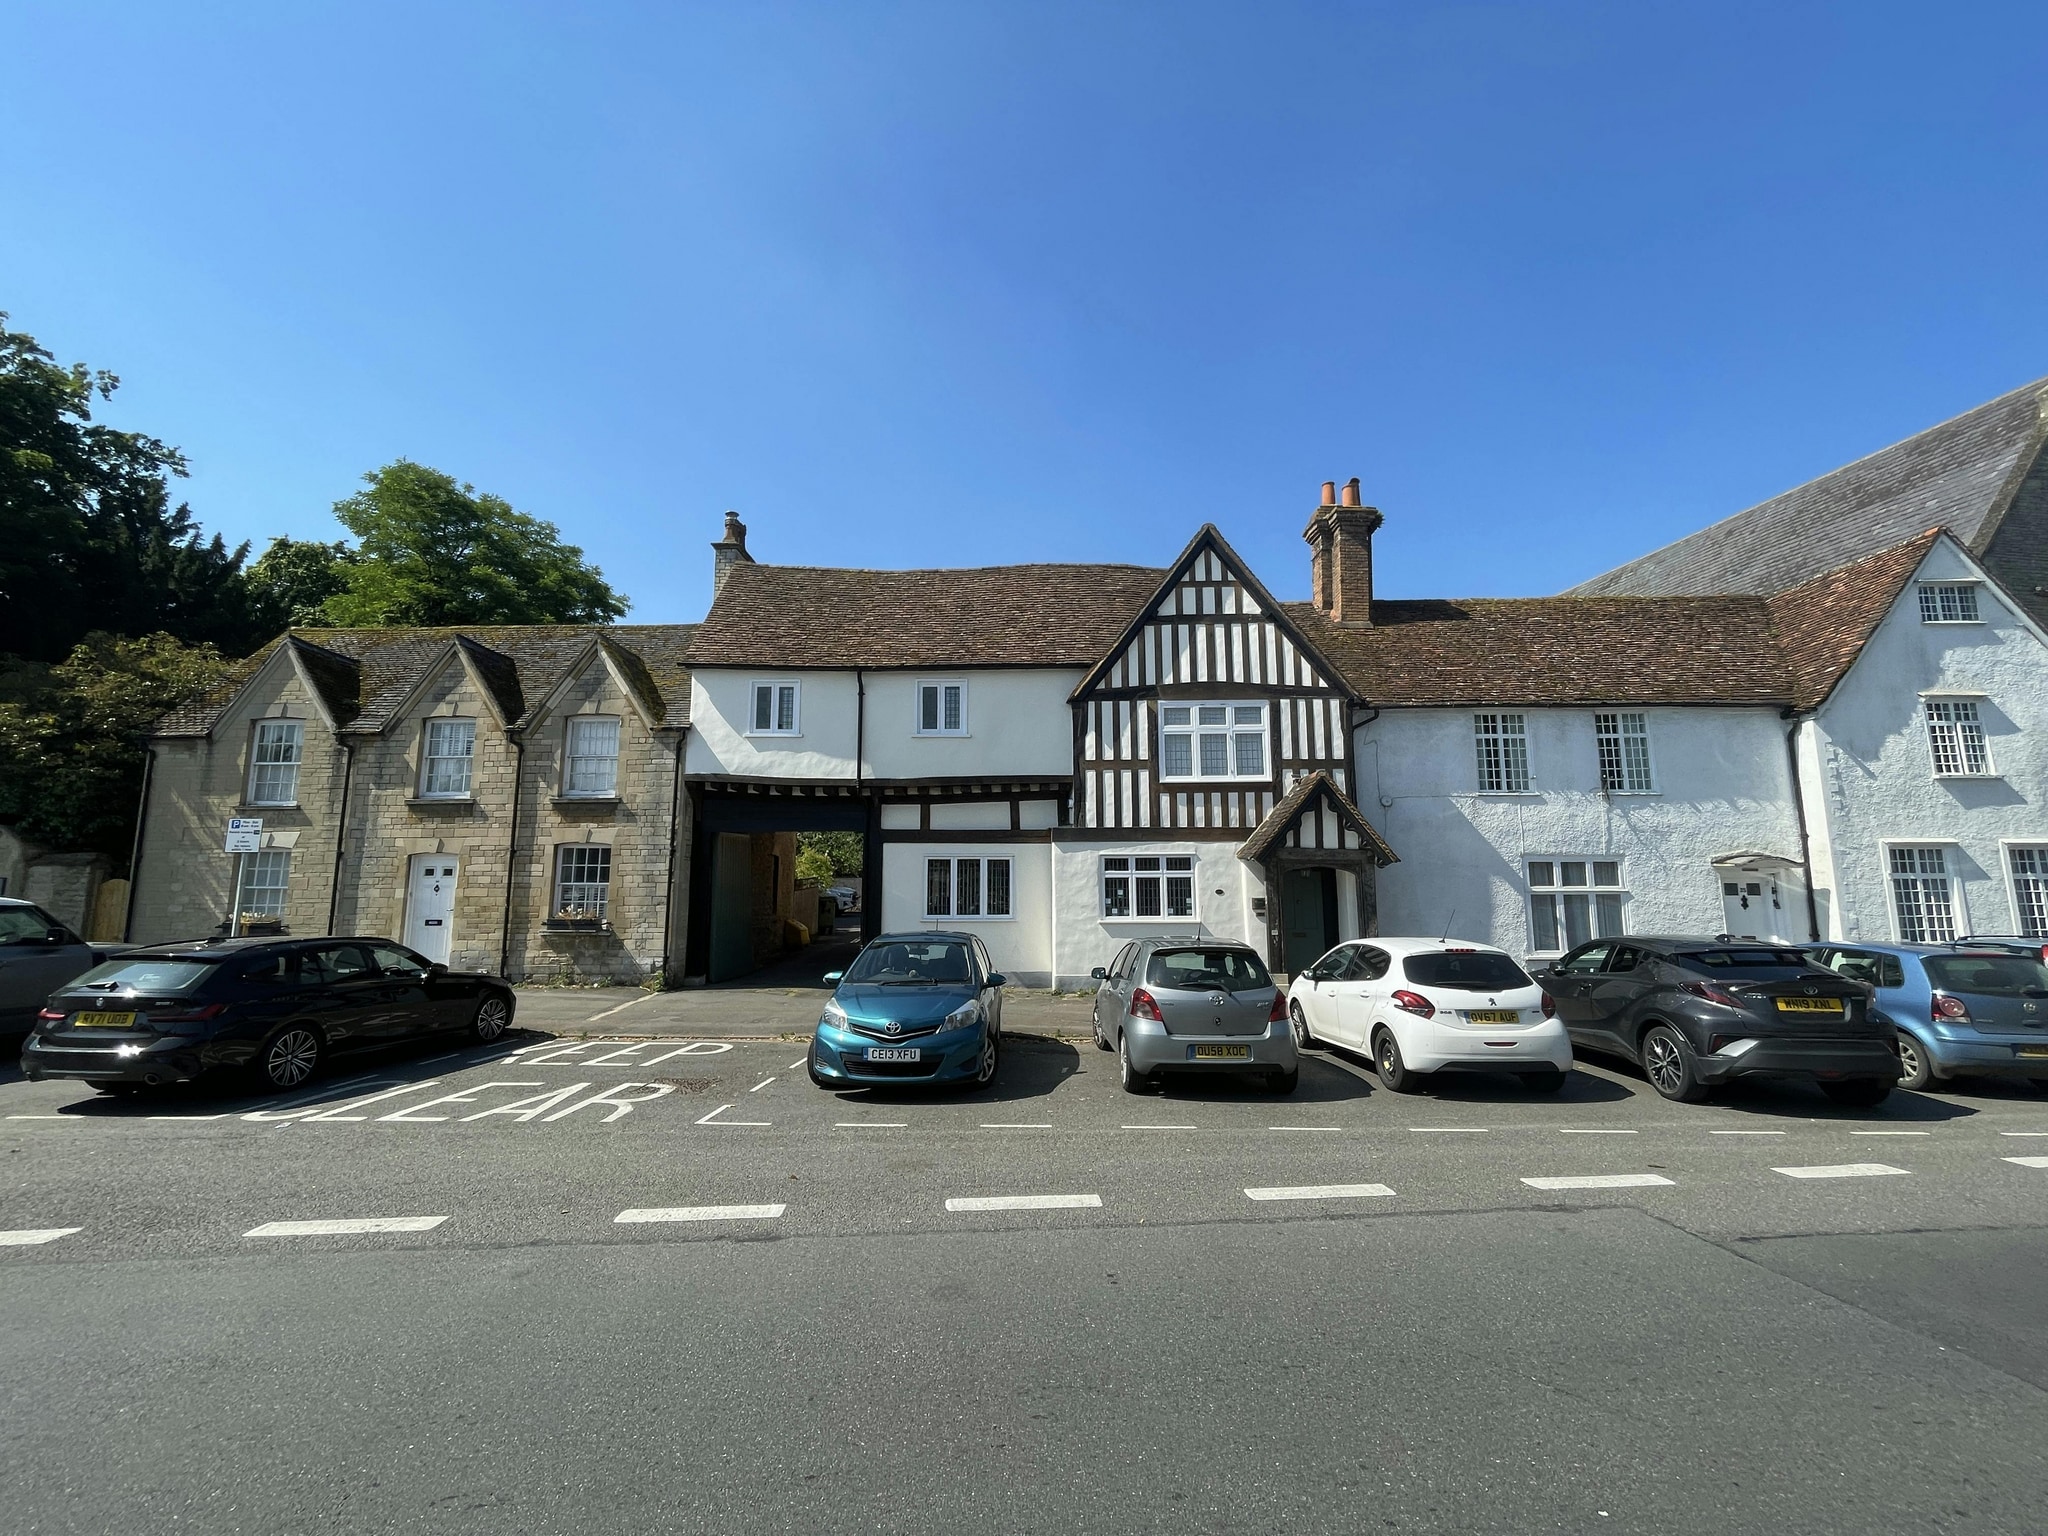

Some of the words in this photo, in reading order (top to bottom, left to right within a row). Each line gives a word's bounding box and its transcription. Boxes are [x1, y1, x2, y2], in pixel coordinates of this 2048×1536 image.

[1470, 1012, 1496, 1022] OV67
[1499, 1012, 1517, 1022] AUF
[500, 1039, 734, 1067] KEEP
[871, 1049, 894, 1059] CE13
[897, 1049, 917, 1059] XFU
[1197, 1047, 1223, 1056] OU58
[1225, 1047, 1245, 1056] XOC
[240, 1081, 678, 1123] CLEAR
